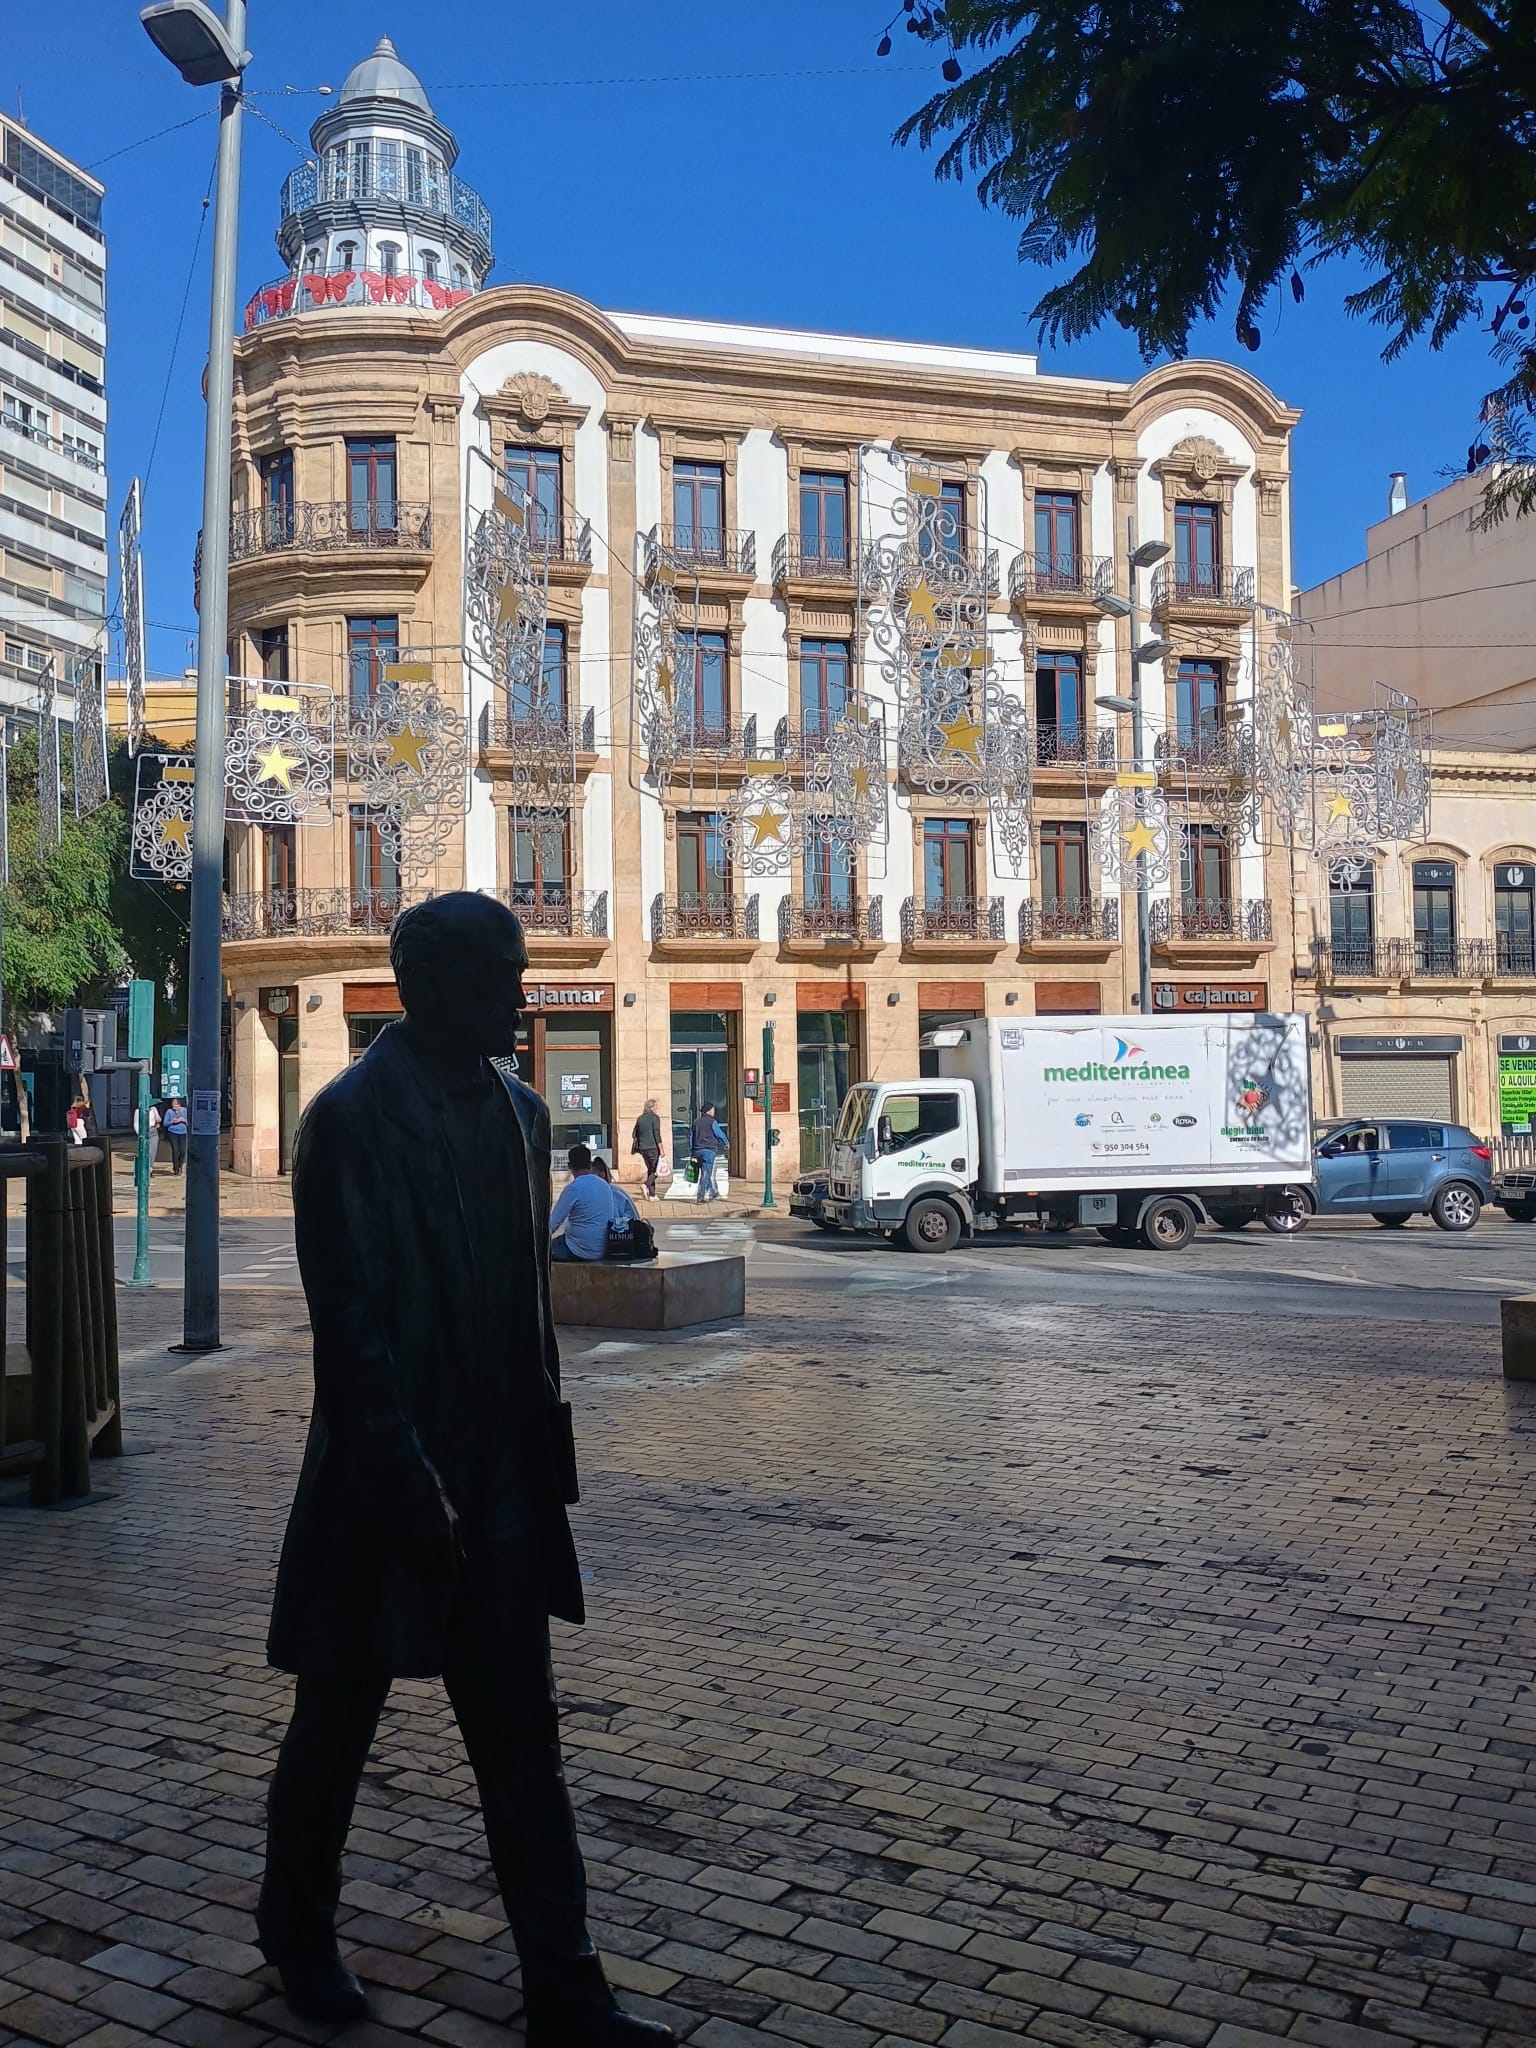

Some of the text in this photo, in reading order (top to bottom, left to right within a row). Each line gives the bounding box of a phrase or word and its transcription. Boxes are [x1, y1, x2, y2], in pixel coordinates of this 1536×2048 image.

[524, 985, 605, 1009] ajamar
[1184, 985, 1258, 1008] cajamar
[1044, 1061, 1190, 1081] mediterránea
[1500, 1059, 1510, 1071] SE
[1501, 1075, 1506, 1086] O
[1221, 1126, 1264, 1136] elegir bien
[1104, 1142, 1149, 1152] 950 304 564
